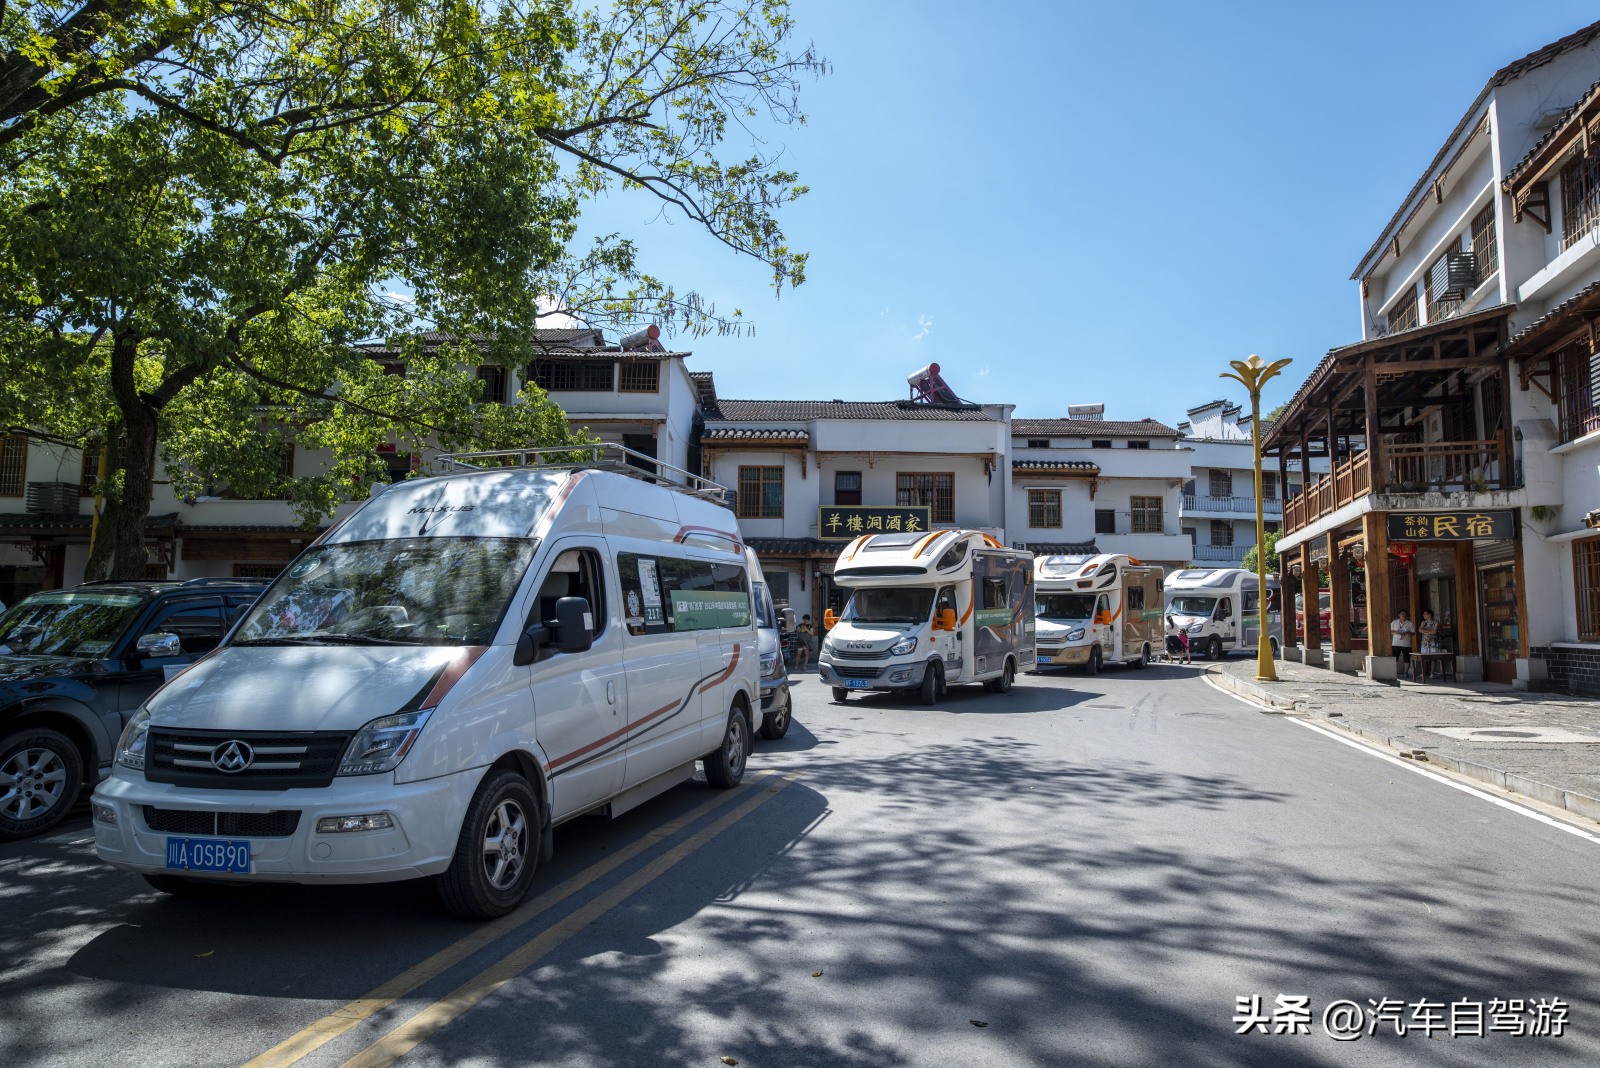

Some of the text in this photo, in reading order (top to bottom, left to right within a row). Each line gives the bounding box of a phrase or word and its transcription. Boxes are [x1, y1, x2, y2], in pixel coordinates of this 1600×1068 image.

[406, 505, 475, 515] MAXUS
[825, 512, 924, 533] 羊樓洞酒家
[1433, 514, 1495, 537] 民宿
[647, 608, 660, 620] 217
[846, 641, 873, 649] IVECO
